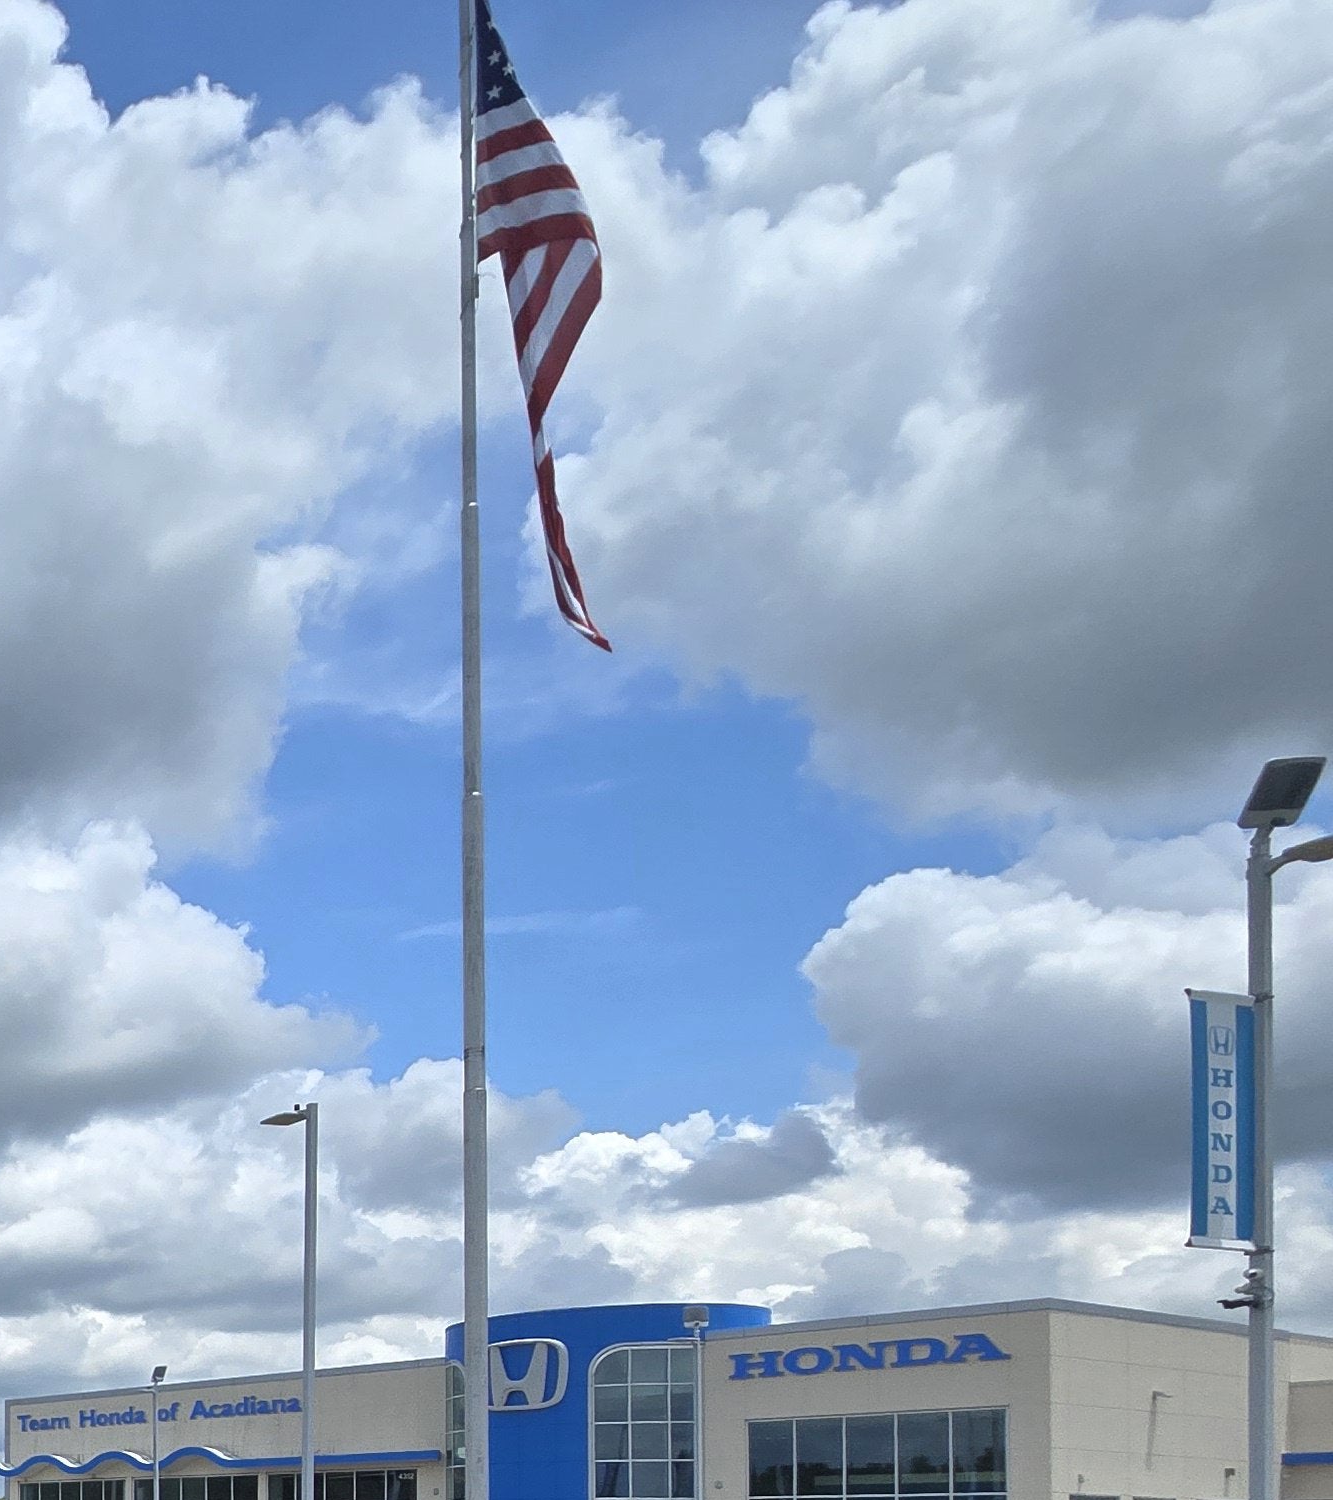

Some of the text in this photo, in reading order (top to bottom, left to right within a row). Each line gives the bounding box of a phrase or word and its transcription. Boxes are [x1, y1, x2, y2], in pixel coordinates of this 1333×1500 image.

[1210, 1067, 1234, 1216] HONDA
[729, 1332, 1011, 1381] HONDA
[17, 1395, 303, 1433] Team Honda of Acadiana
